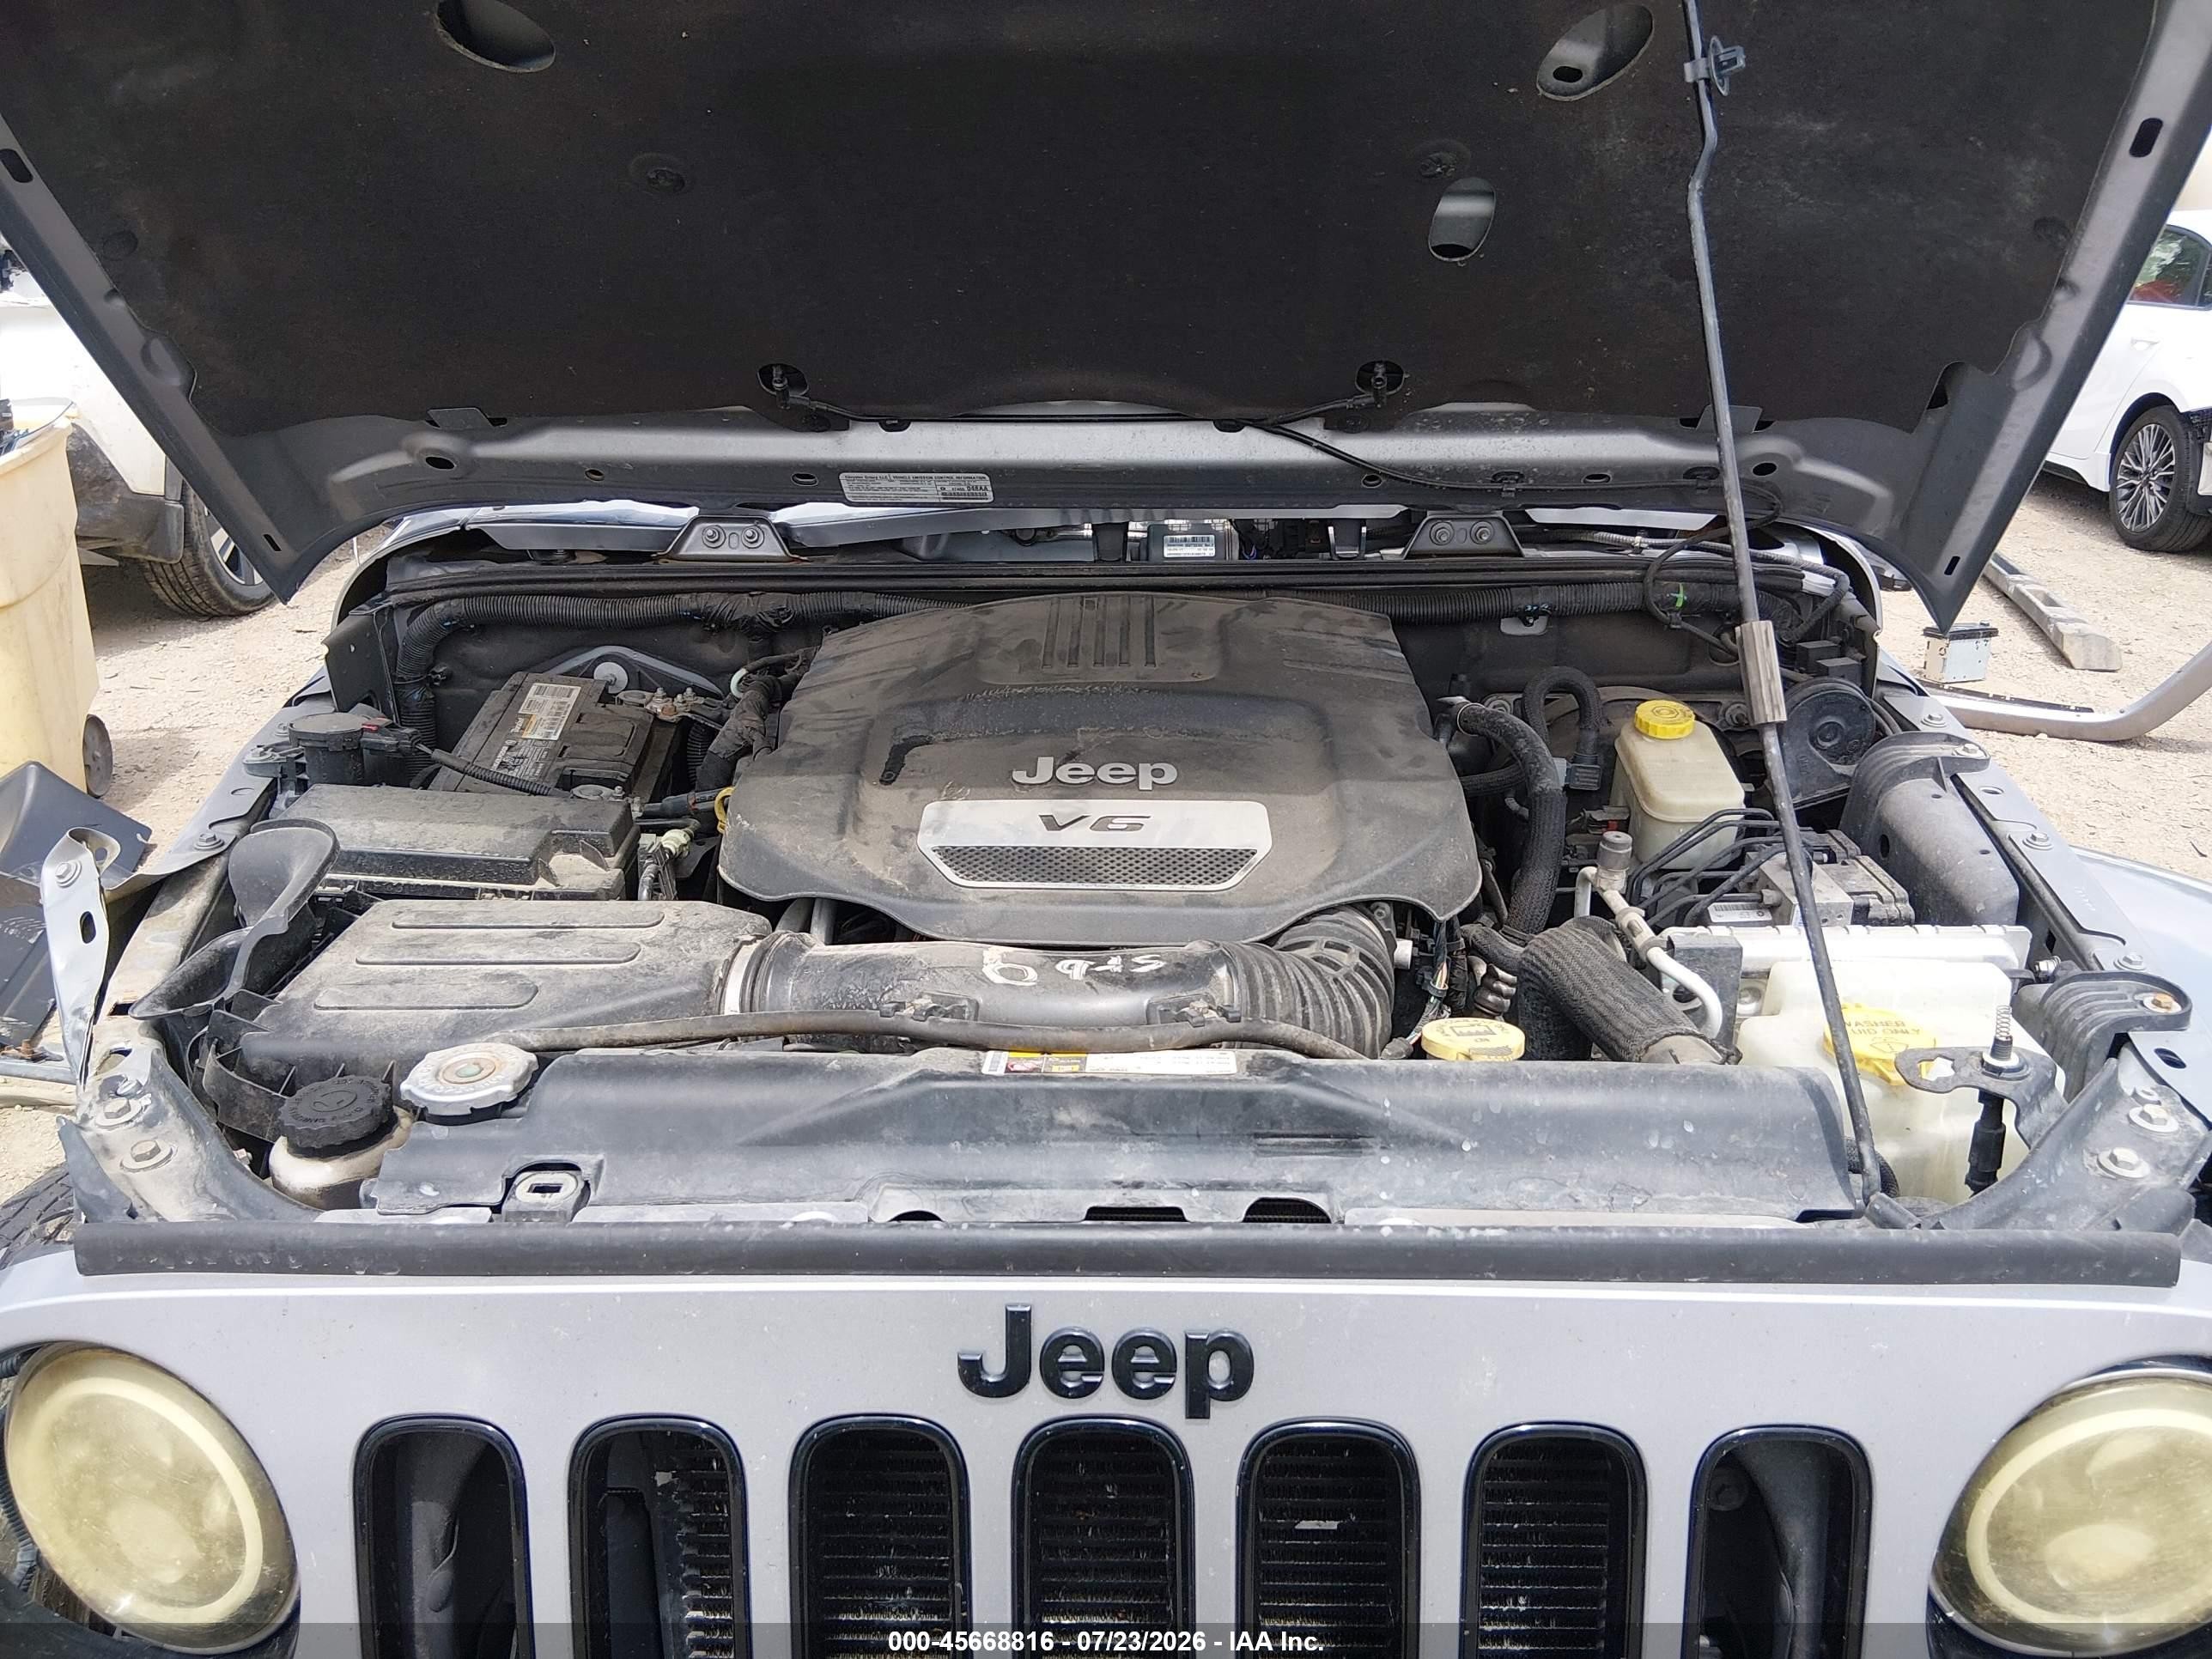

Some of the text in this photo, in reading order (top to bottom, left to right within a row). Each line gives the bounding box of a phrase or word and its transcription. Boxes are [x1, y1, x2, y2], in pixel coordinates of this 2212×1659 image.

[1012, 757, 1178, 791] Jeep
[1038, 815, 1152, 831] V6
[957, 1304, 1254, 1419] Jeep
